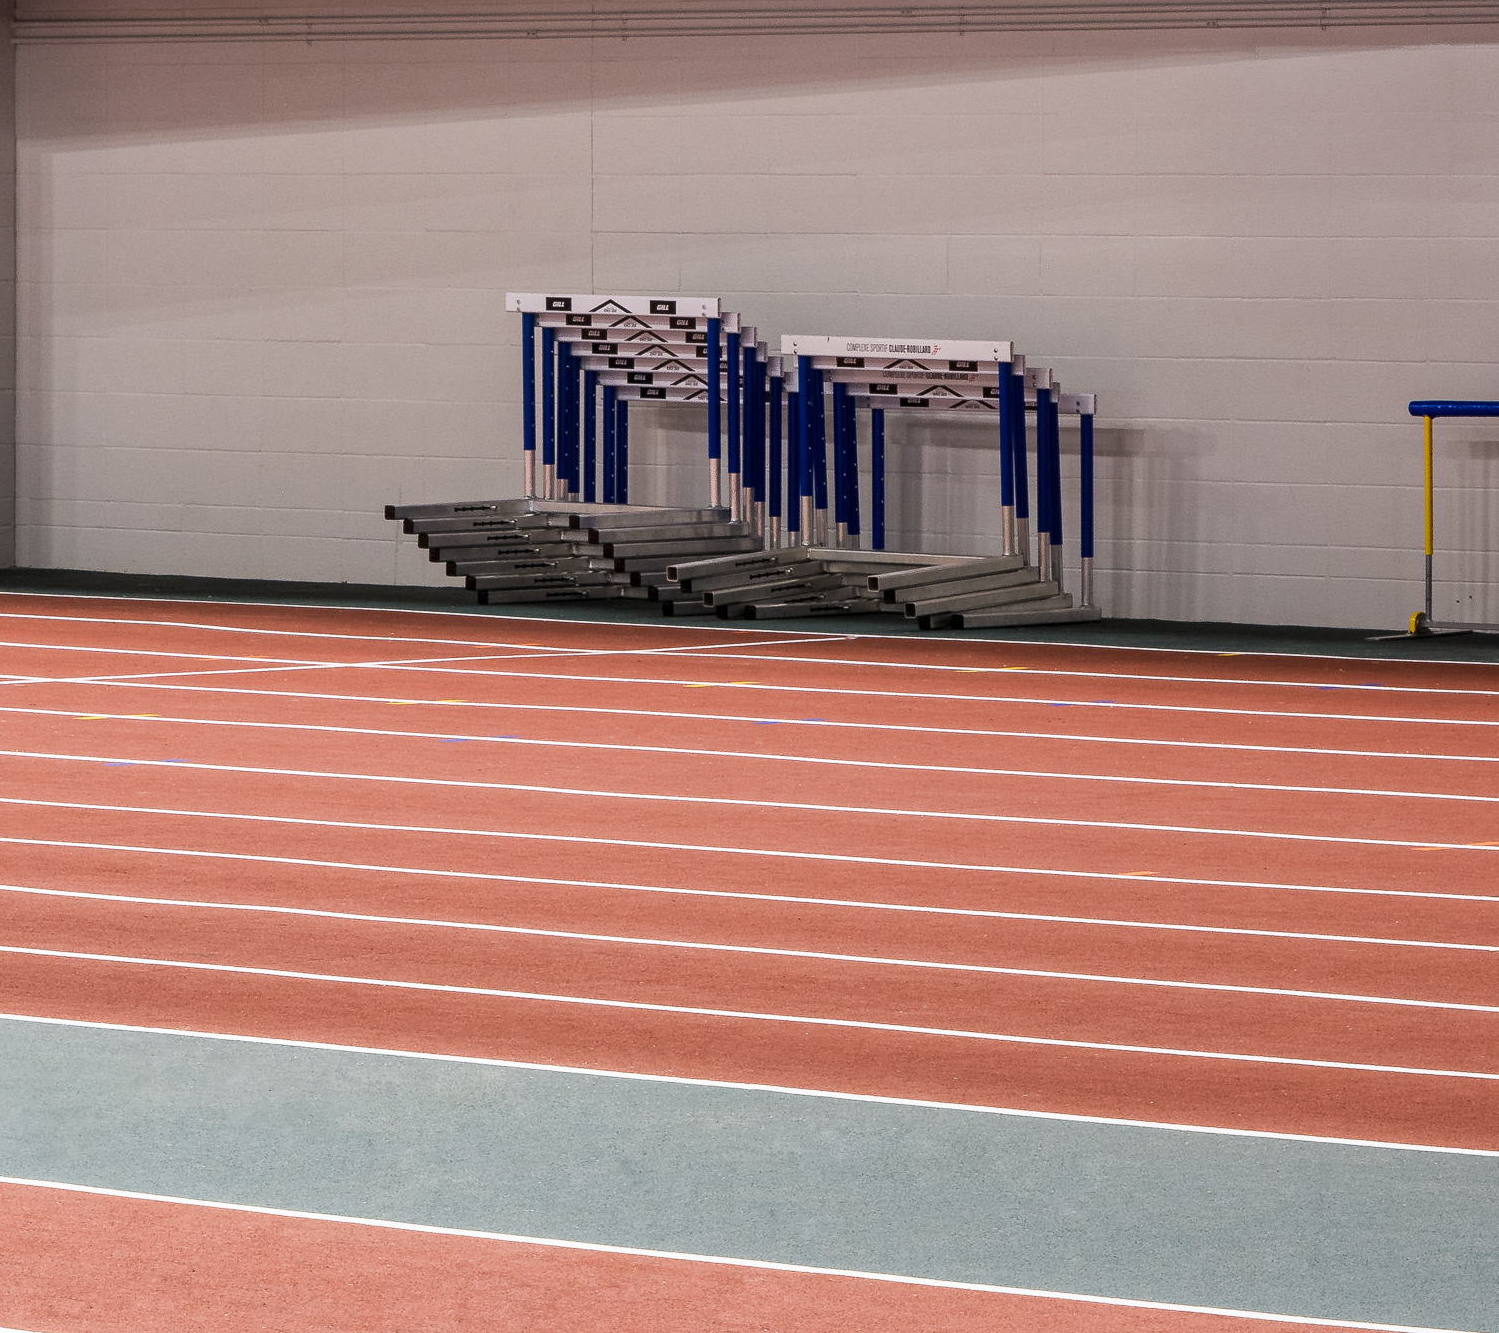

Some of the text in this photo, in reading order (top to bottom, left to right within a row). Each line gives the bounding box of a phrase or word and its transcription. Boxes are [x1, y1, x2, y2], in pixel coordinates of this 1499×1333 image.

[846, 343, 931, 354] COMPLEXE SPORTIF CLAUDE-ROBILLARD
